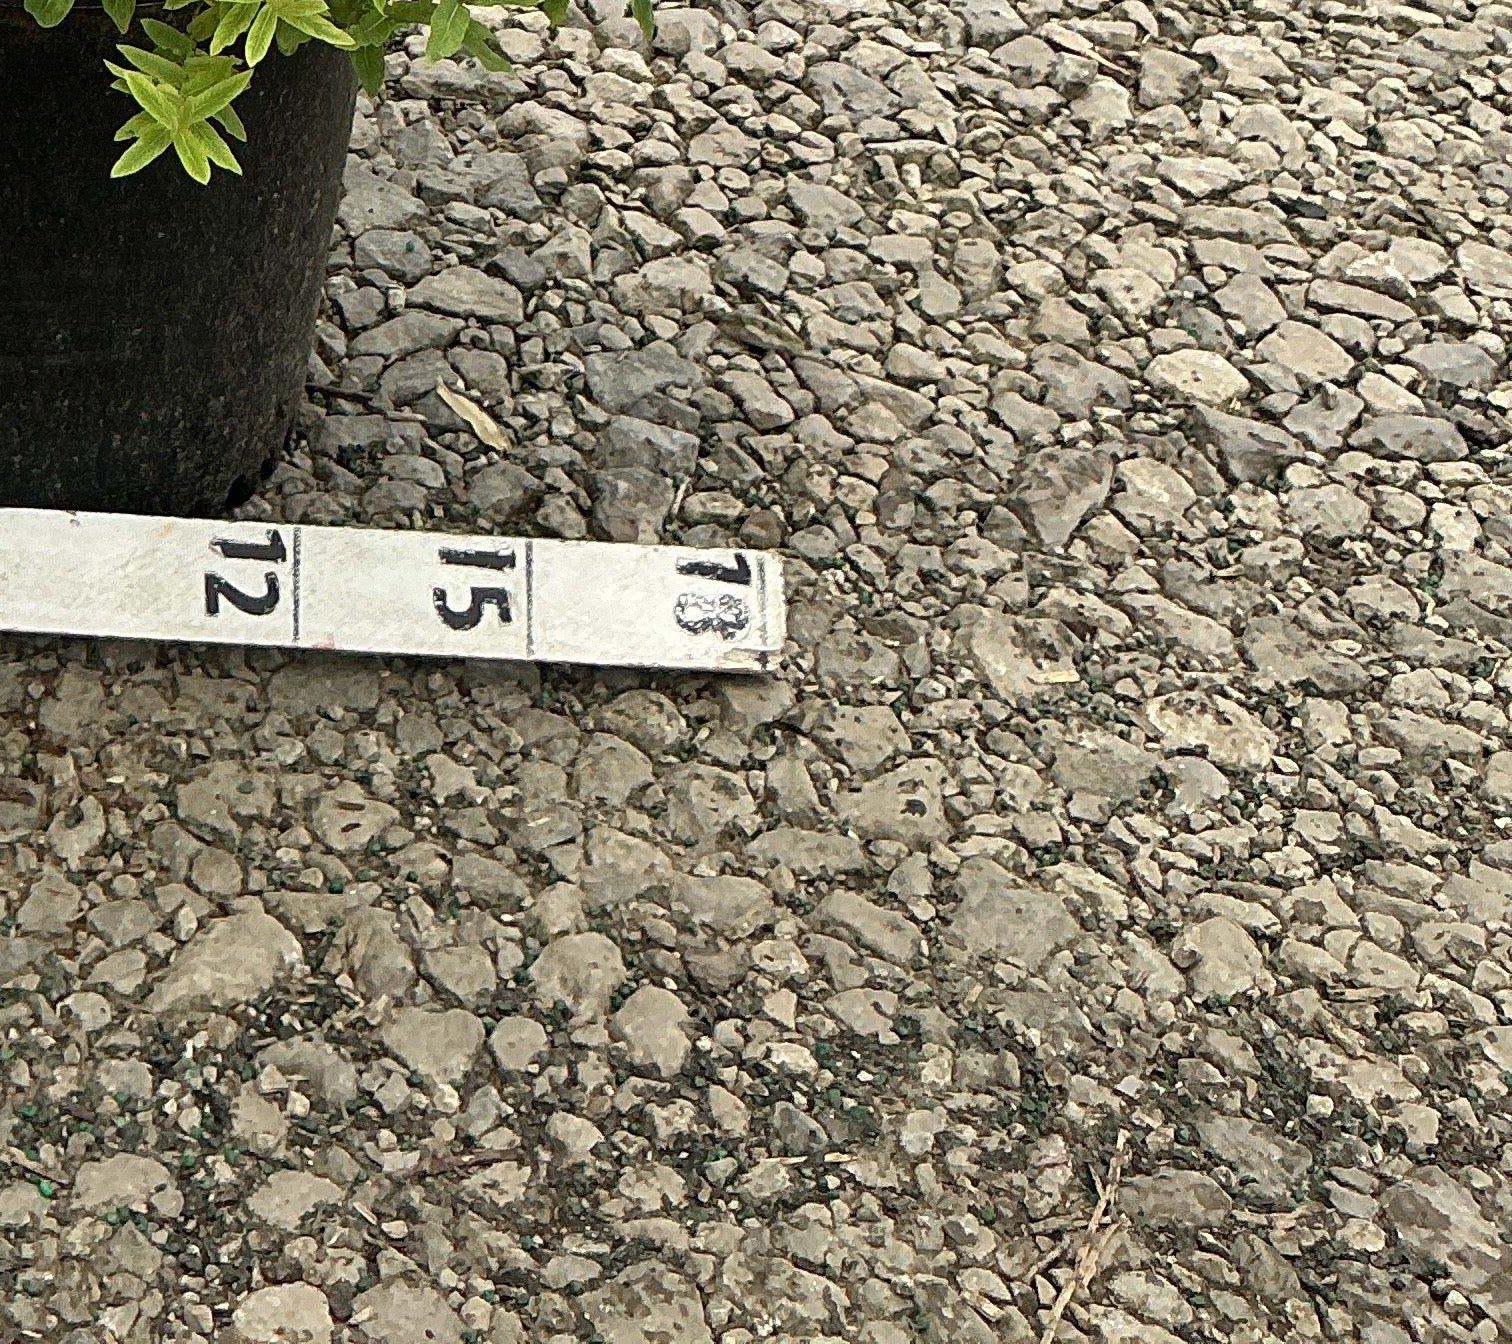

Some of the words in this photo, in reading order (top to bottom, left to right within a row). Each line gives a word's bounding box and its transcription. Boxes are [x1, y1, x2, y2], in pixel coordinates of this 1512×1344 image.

[204, 528, 287, 617] 12
[433, 546, 516, 631] 15
[673, 552, 752, 641] 18
